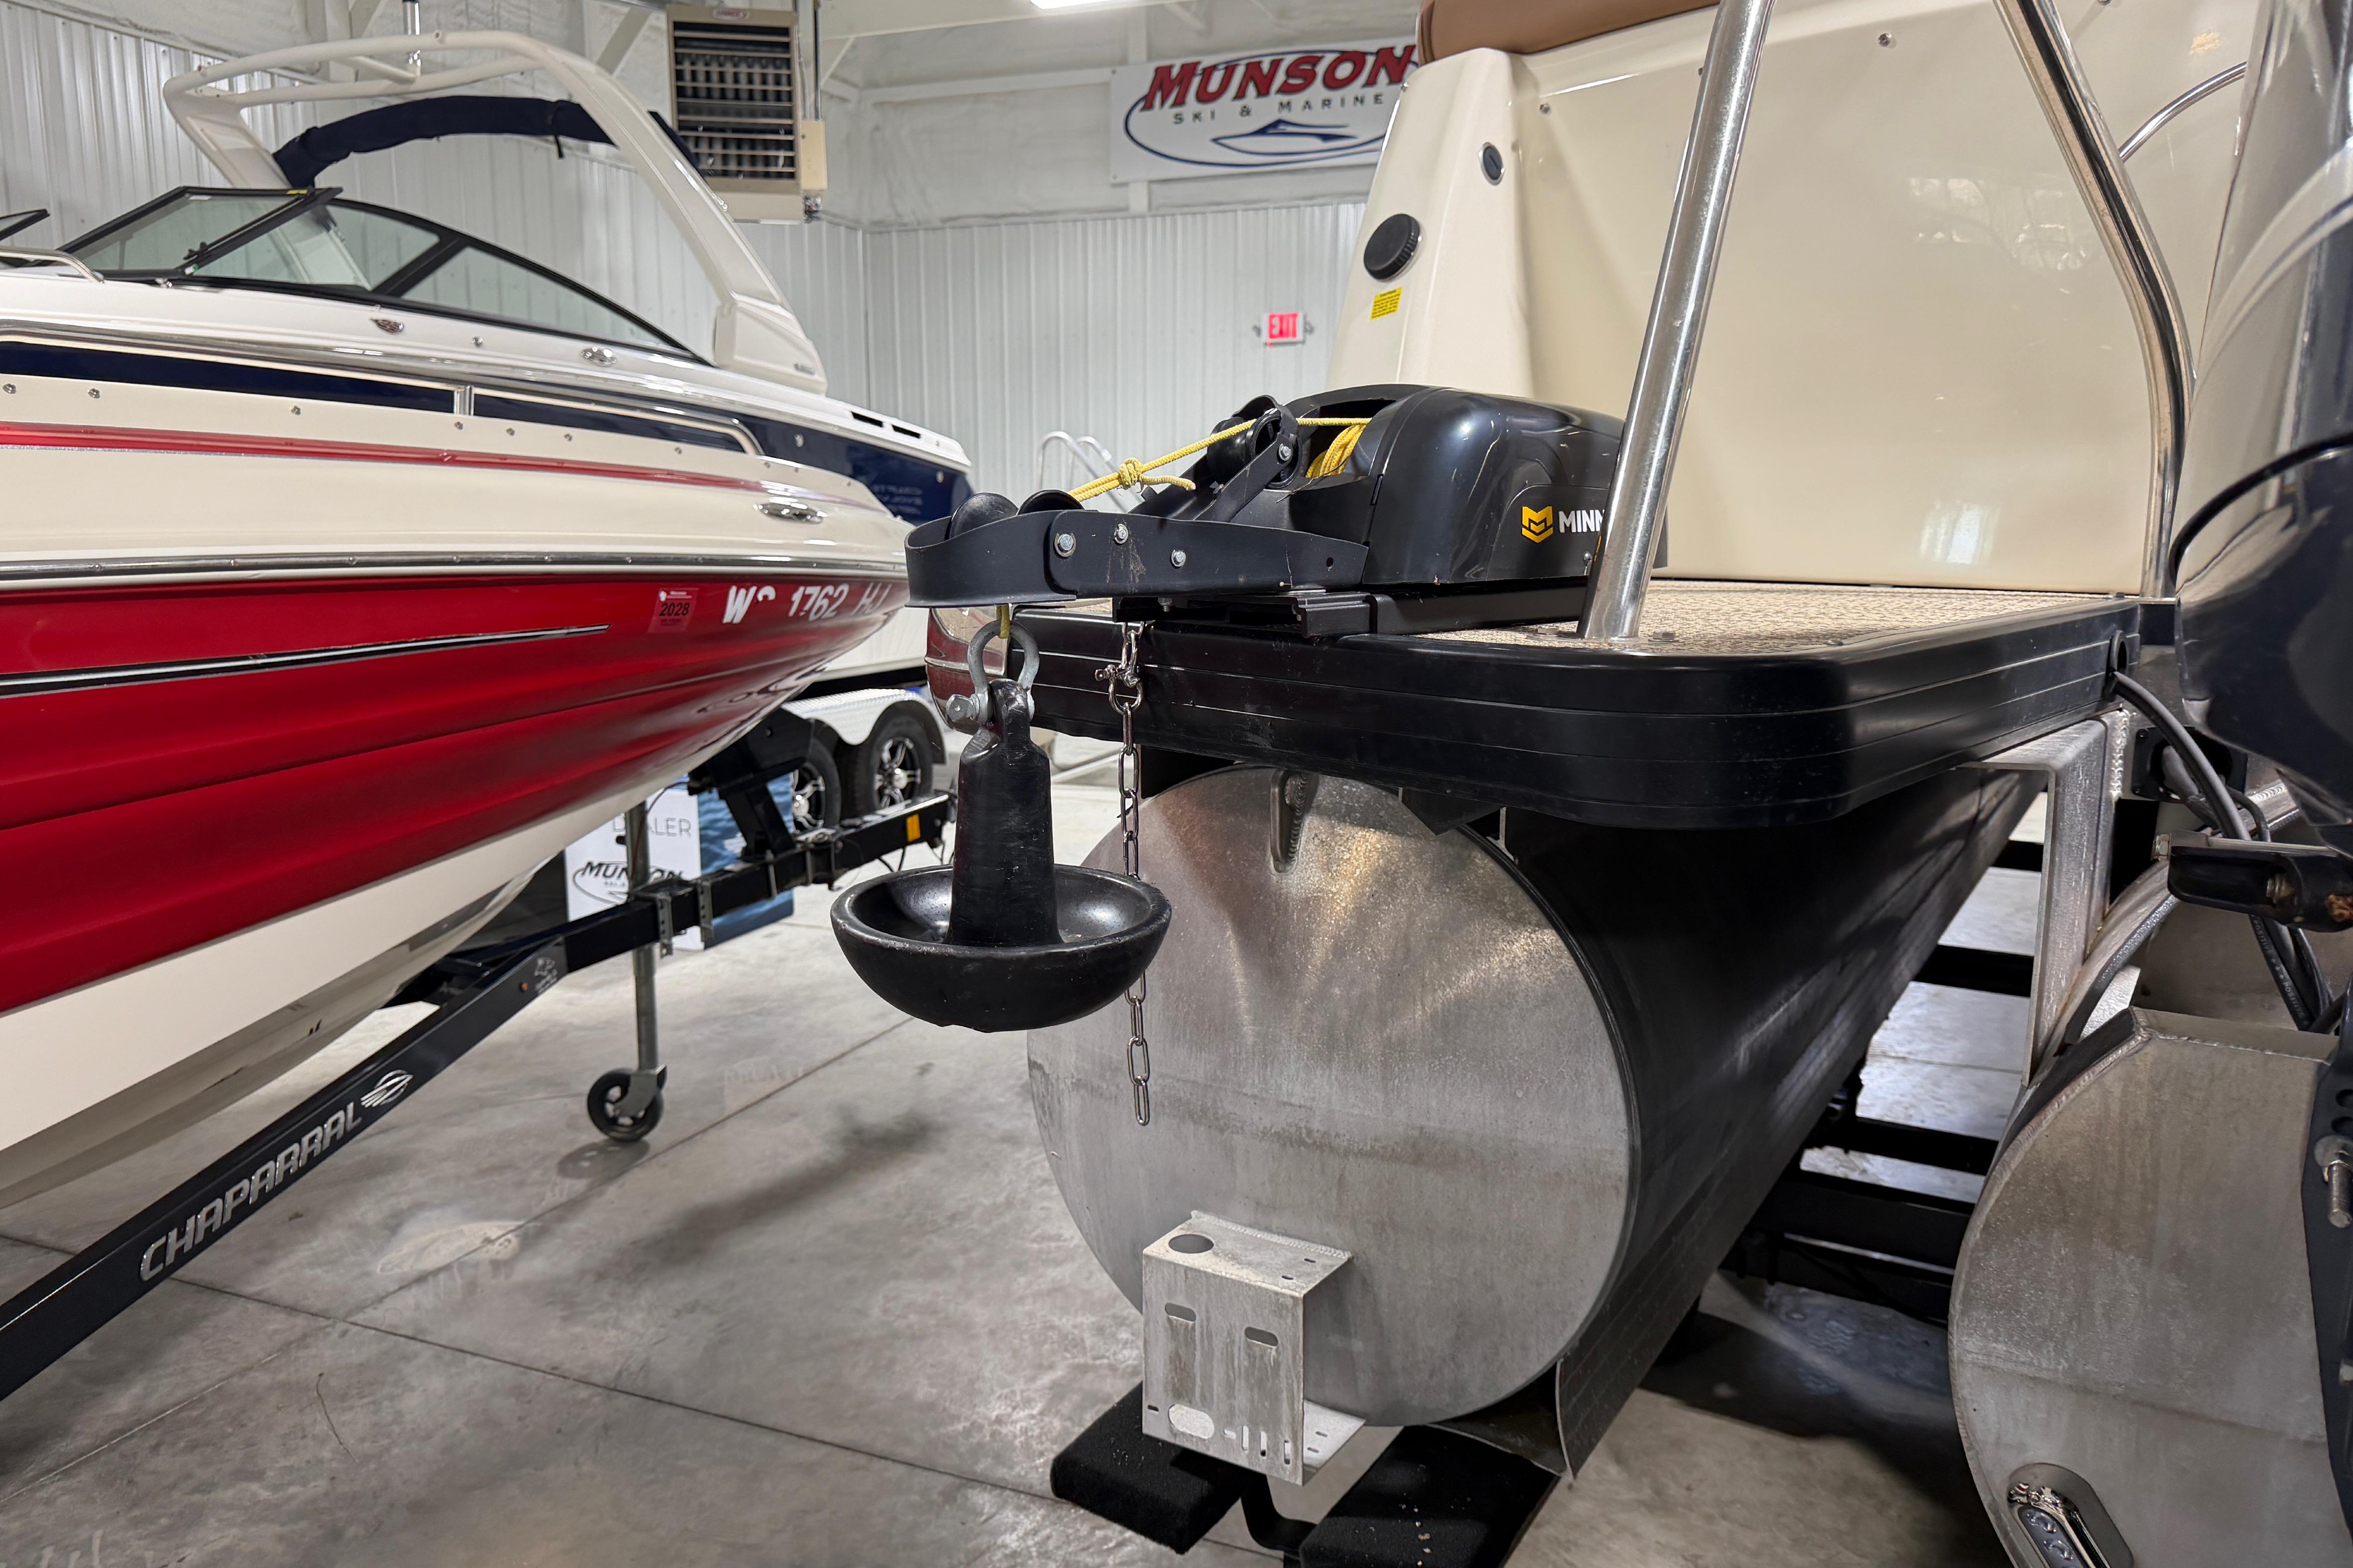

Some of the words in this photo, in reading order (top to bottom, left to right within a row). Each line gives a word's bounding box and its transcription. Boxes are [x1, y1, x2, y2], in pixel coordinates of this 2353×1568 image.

[1140, 45, 1417, 112] MUNSON
[1172, 111, 1216, 125] SKI
[1238, 105, 1252, 117] &
[1278, 94, 1384, 113] MARINE
[1268, 312, 1298, 339] EXIT
[659, 602, 690, 616] 2028
[788, 583, 850, 621] 1762
[613, 816, 692, 837] DLER
[580, 861, 684, 880] MUNON
[140, 1101, 363, 1281] CHAPARRAL
